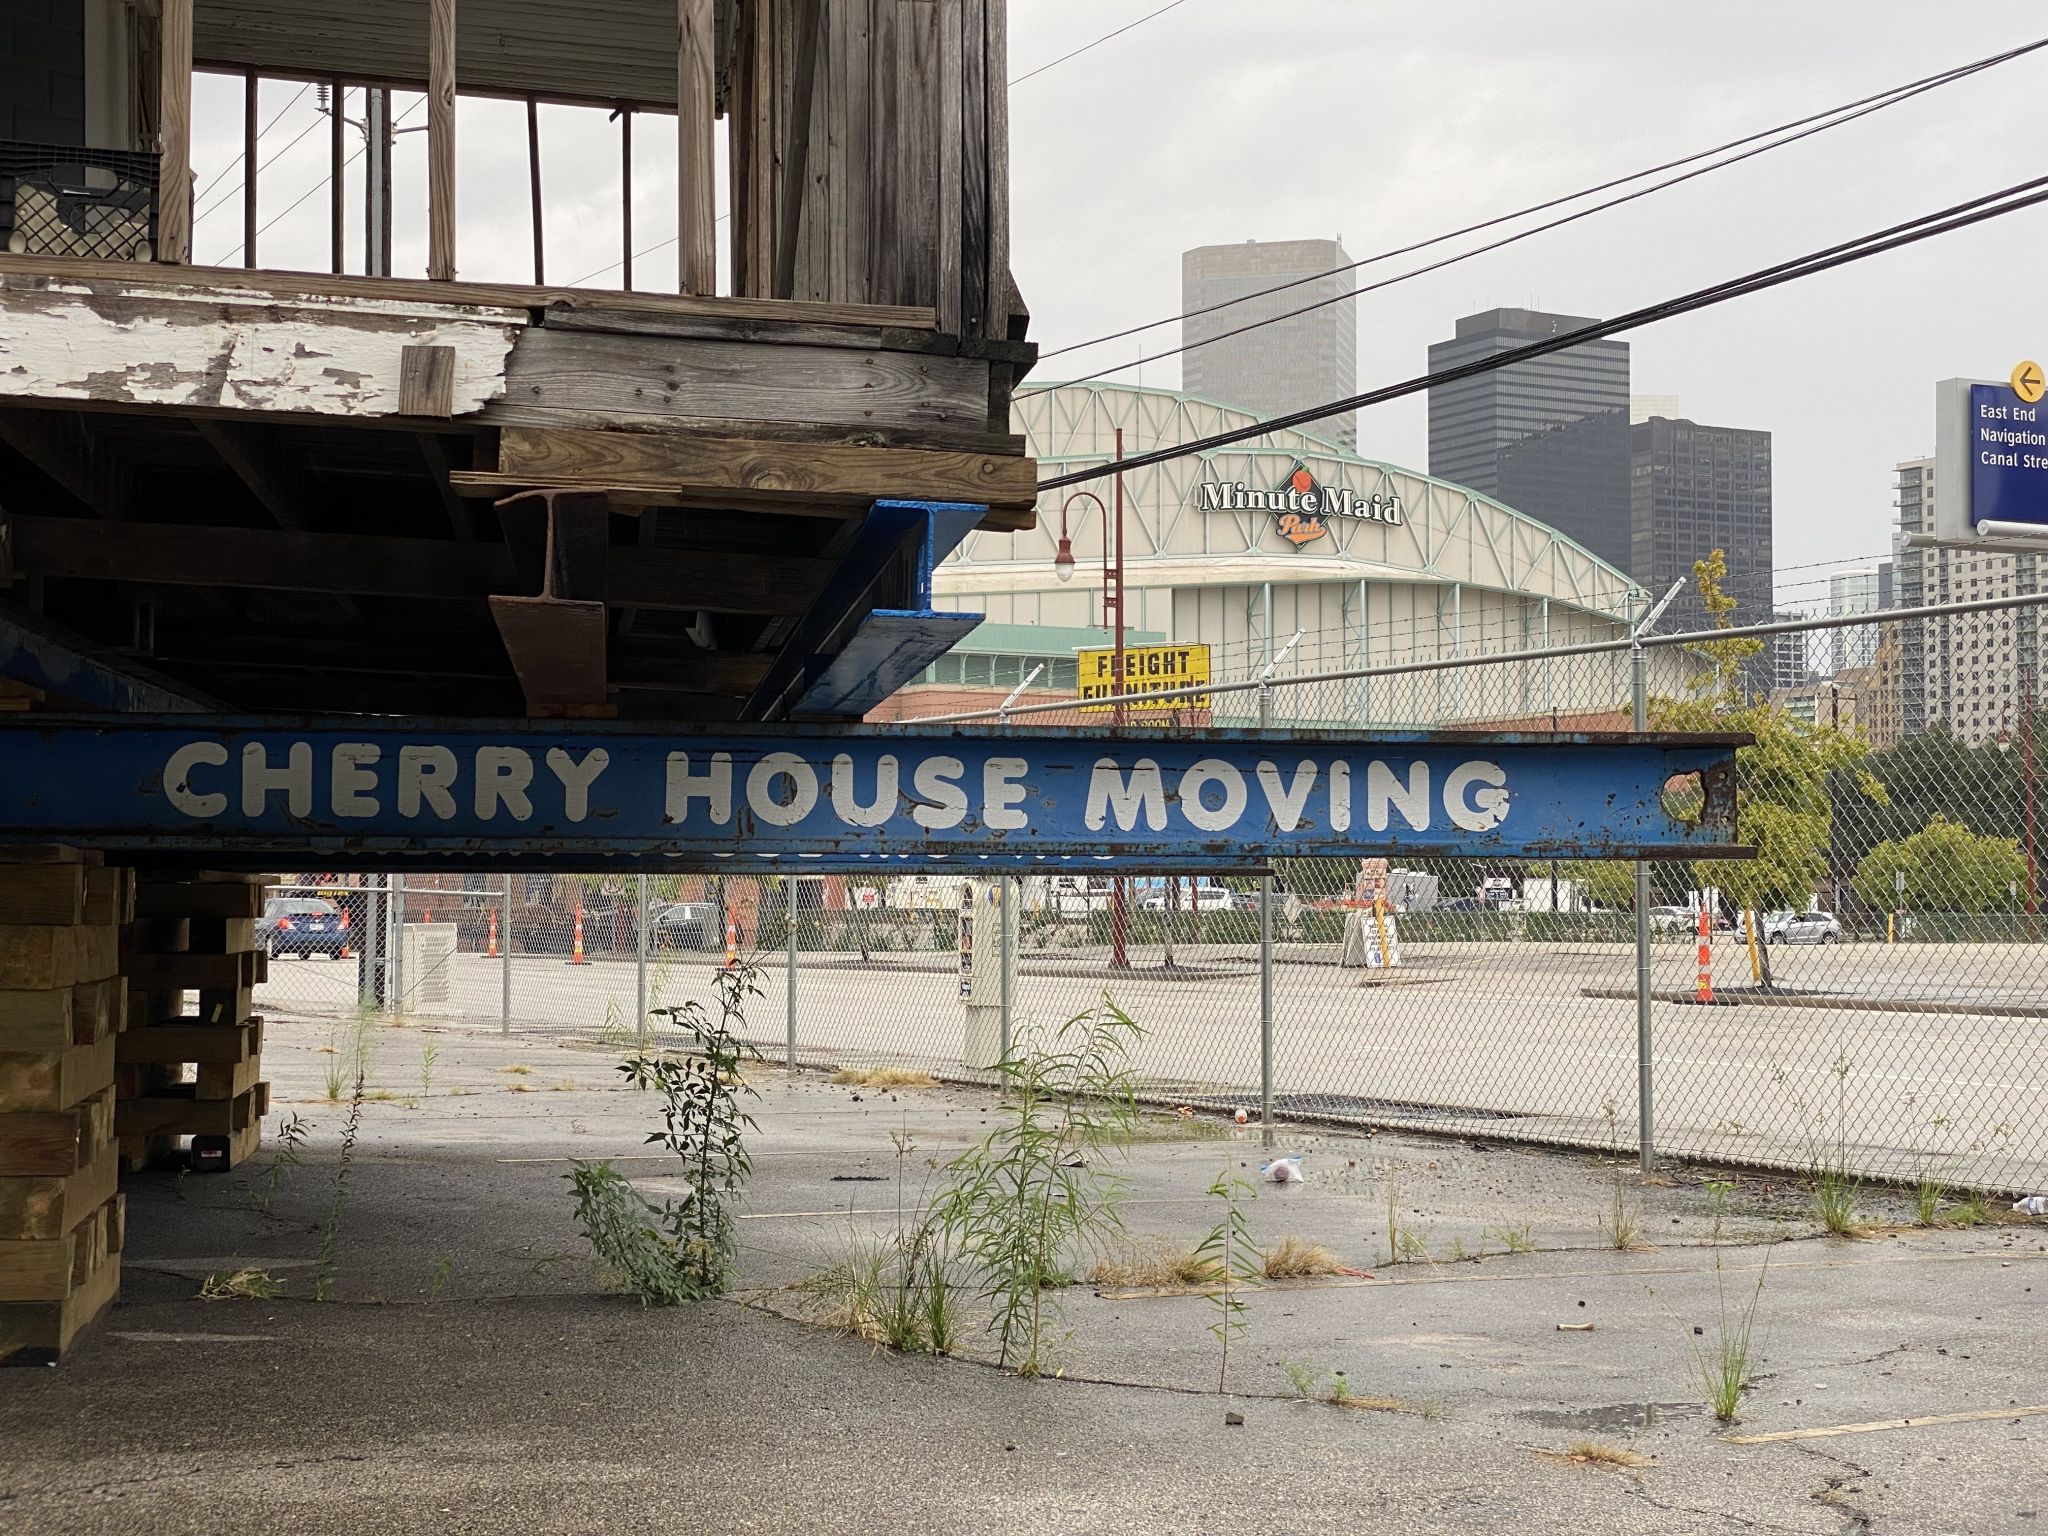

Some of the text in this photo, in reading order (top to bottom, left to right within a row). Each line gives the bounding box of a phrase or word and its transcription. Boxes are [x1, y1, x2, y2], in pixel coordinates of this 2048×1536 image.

[1980, 404, 2036, 422] East End
[1980, 428, 2046, 447] Navigation
[1981, 451, 2018, 467] Canal
[1200, 482, 1403, 526] Minute Maid
[1277, 514, 1327, 541] Park
[162, 741, 1510, 832] CHERRY HOUSE MOVING
